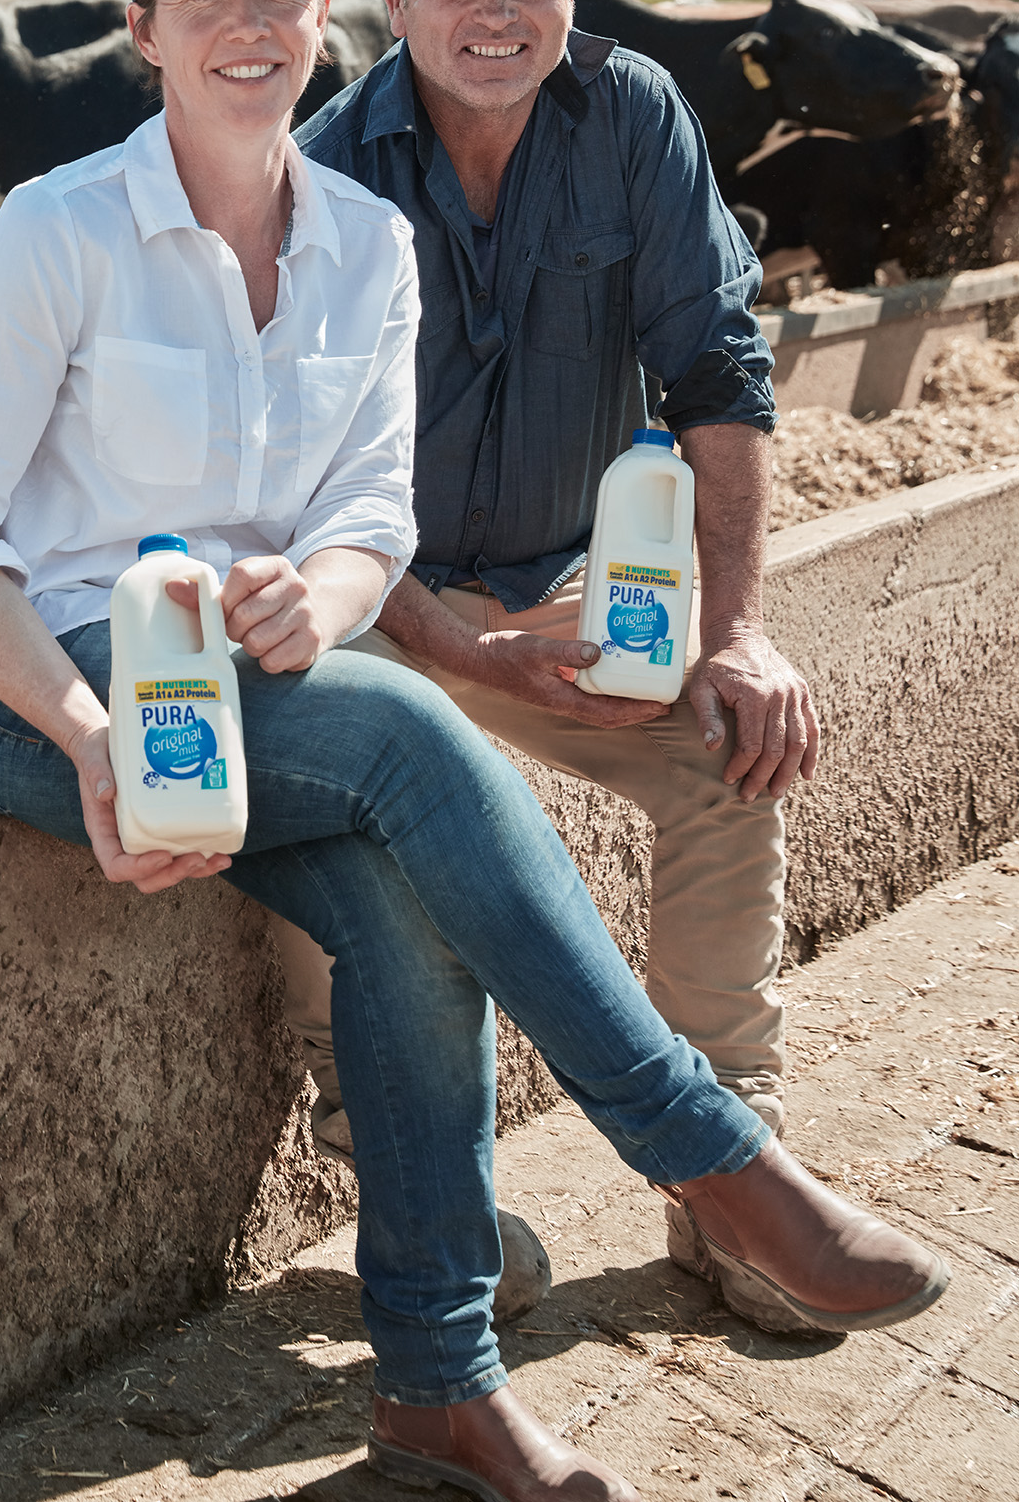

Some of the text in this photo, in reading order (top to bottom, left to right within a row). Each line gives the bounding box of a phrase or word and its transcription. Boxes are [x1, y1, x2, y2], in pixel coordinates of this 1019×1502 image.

[625, 565, 670, 578] 8 NUTRIENTS
[624, 573, 633, 581] A1
[640, 575, 649, 583] A2
[650, 576, 676, 587] Protein
[609, 585, 655, 607] PURA
[613, 610, 658, 629] original
[635, 623, 654, 633] milk
[155, 680, 208, 690] 8 NUTRIENTS
[156, 690, 166, 699] A1
[174, 689, 185, 698] A2
[186, 688, 216, 698] Protein
[141, 705, 197, 727] PURA
[151, 727, 203, 754] original
[179, 743, 200, 757] milk
